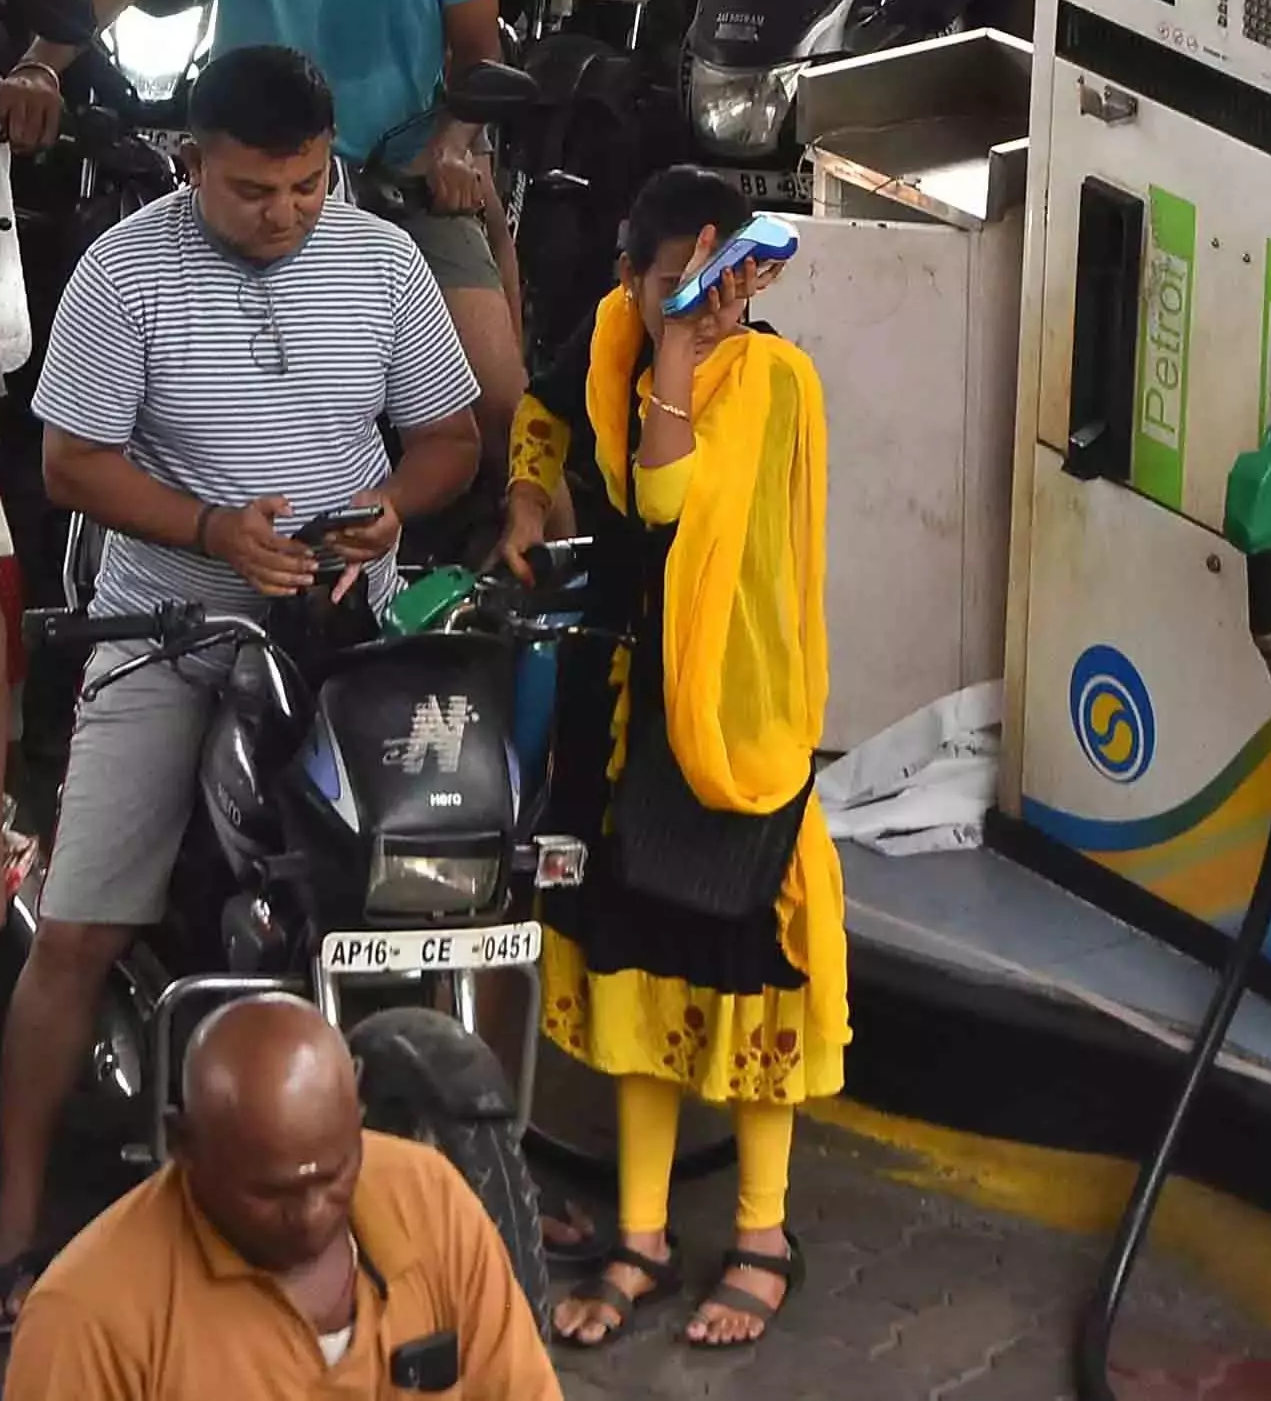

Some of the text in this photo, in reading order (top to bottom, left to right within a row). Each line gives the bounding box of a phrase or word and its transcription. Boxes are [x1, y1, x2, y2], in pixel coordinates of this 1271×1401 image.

[1144, 269, 1188, 434] Petrol
[430, 793, 462, 807] Hero
[421, 937, 452, 963] CE
